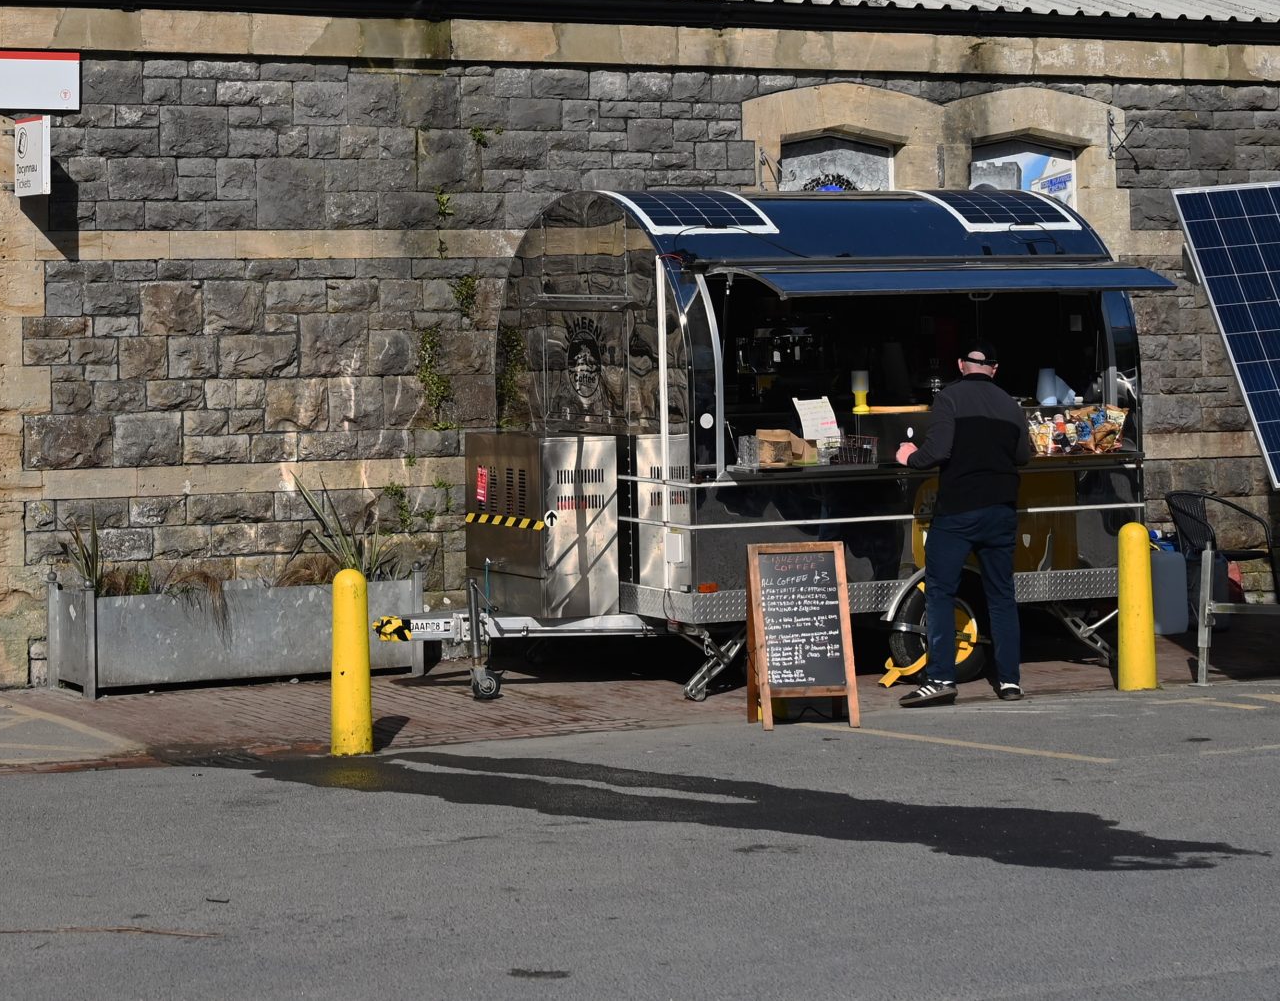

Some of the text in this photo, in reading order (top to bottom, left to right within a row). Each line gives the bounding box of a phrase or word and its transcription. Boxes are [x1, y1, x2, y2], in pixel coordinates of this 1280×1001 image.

[16, 163, 38, 176] Tocynnau
[16, 178, 32, 189] Tickets
[573, 373, 596, 385] Coffee
[761, 578, 774, 587] ALL
